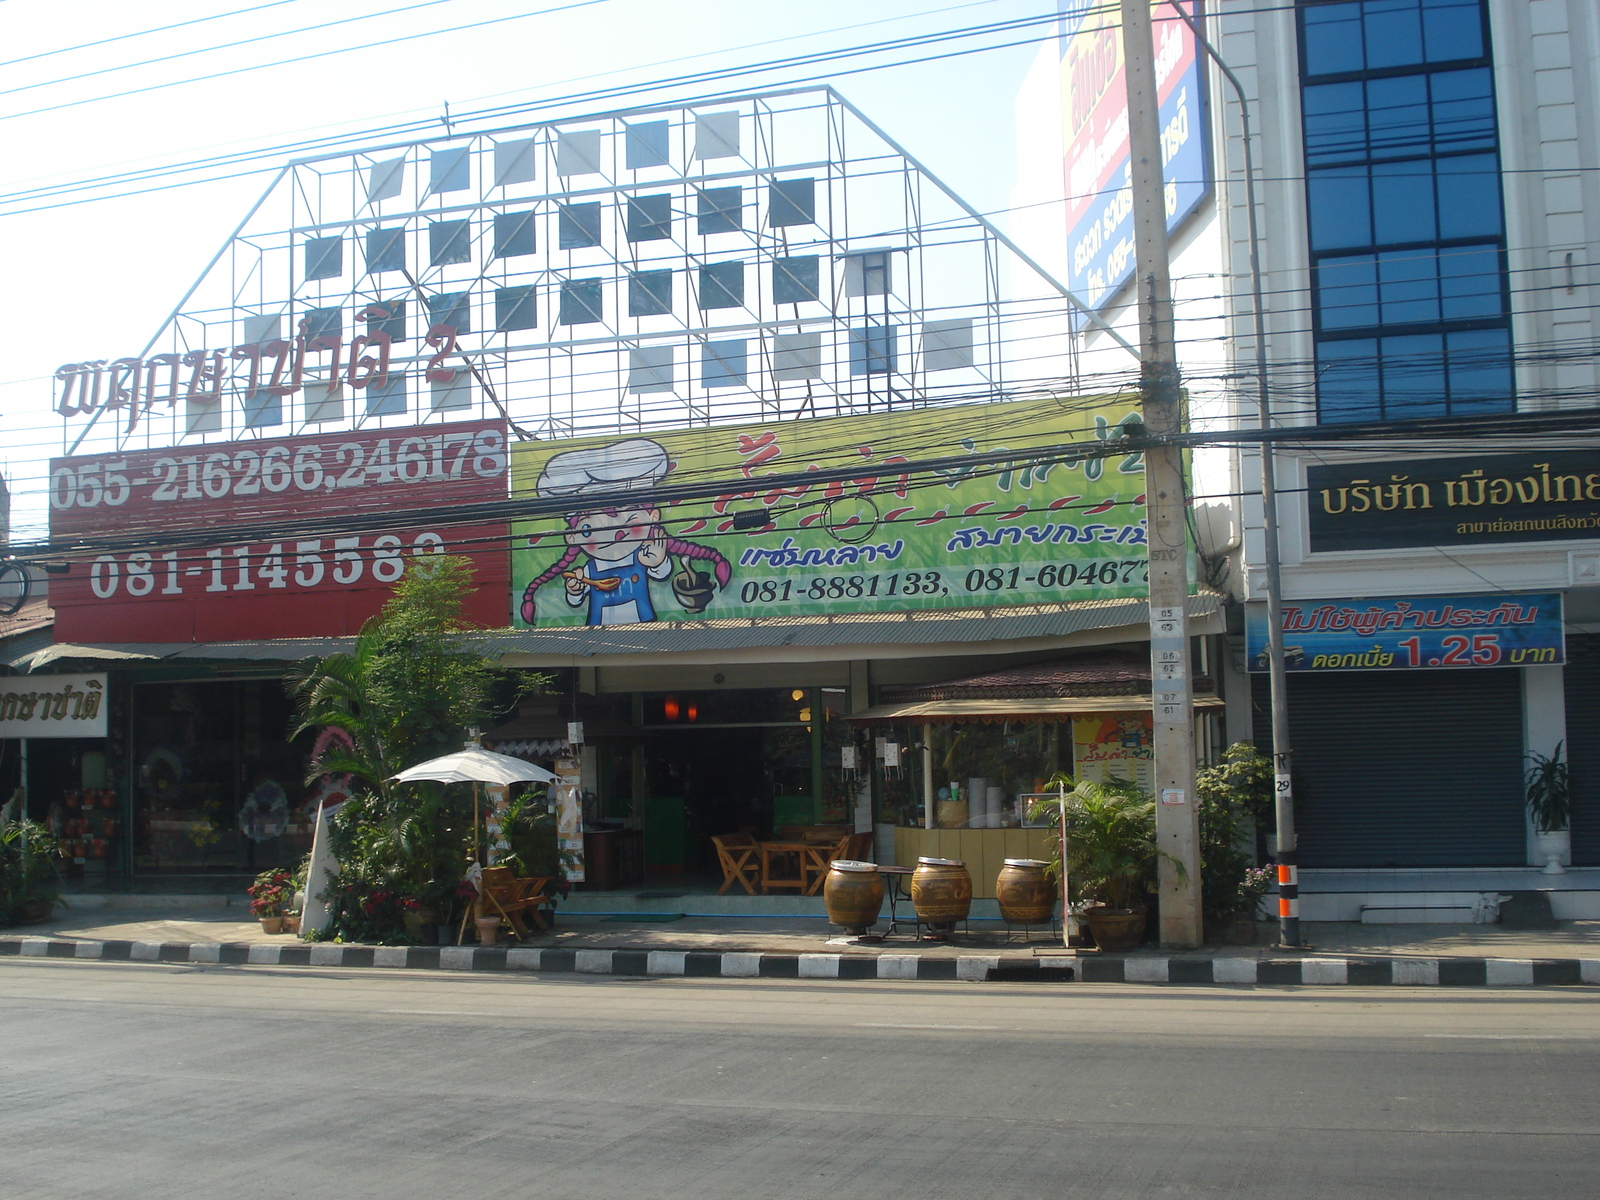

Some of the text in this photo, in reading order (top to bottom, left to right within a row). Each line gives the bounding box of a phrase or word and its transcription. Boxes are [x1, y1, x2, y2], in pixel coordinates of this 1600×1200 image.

[426, 324, 458, 385] 2
[50, 430, 508, 511] 055-216266,246178
[1320, 474, 1432, 515] บริษัท
[741, 571, 949, 604] 081-8881133,
[1312, 635, 1557, 669] ดอกเบี้ย 1.25 บาท
[1165, 706, 1174, 714] 61
[1277, 780, 1290, 792] 29
